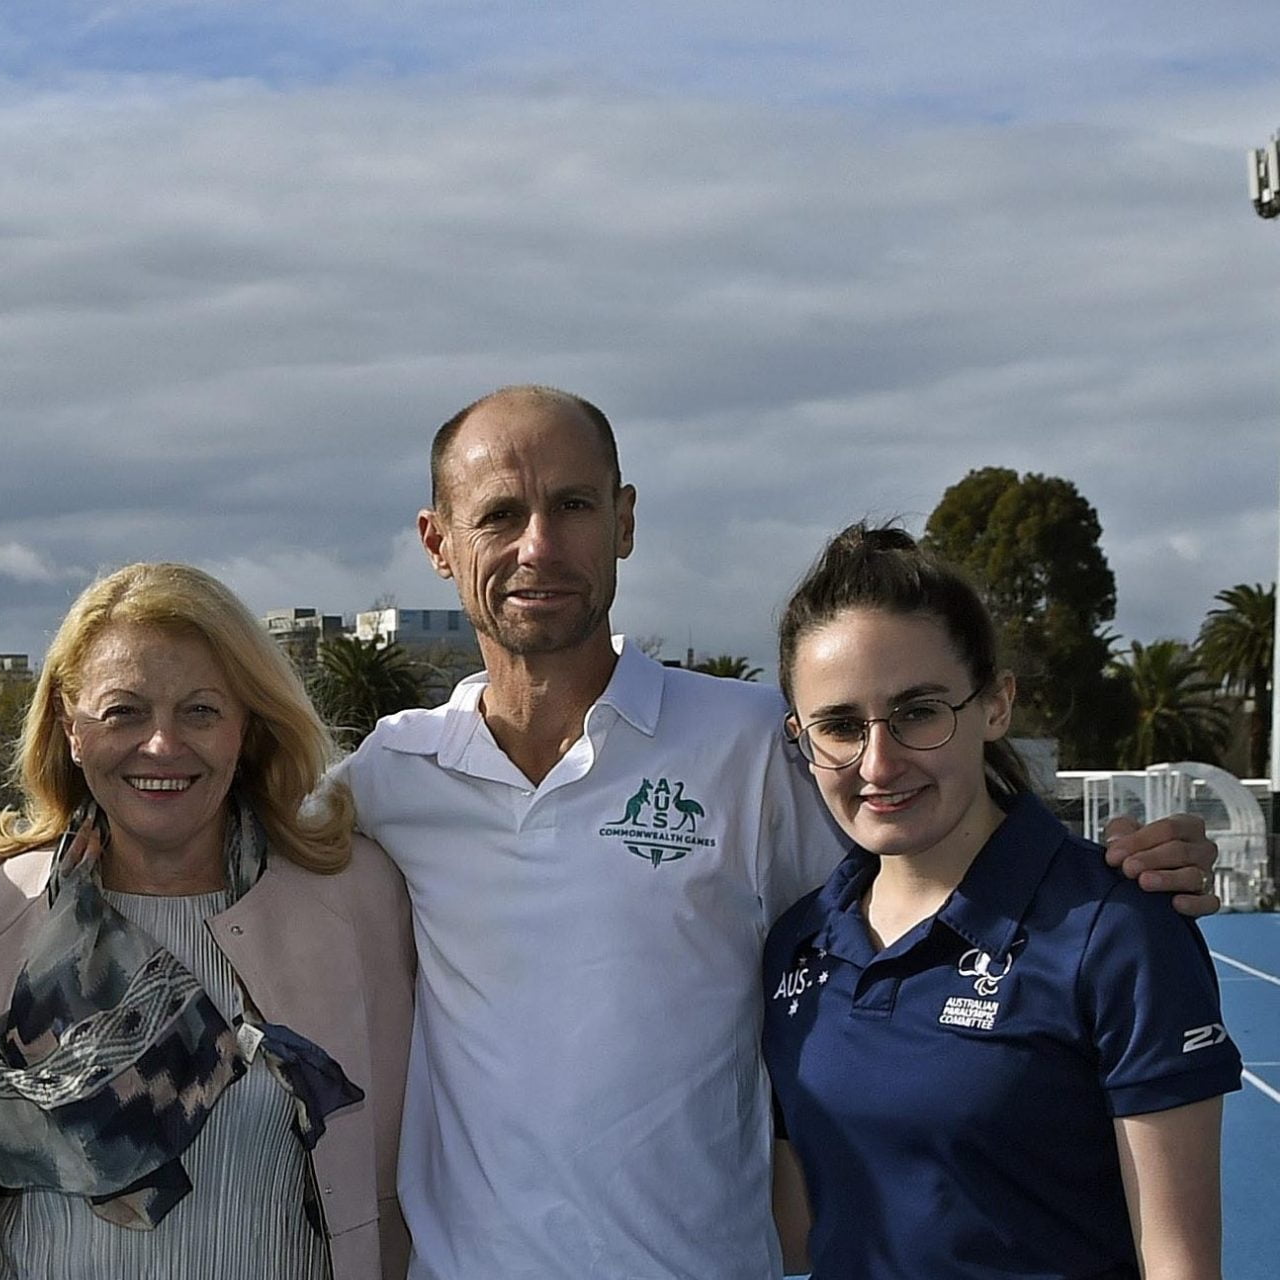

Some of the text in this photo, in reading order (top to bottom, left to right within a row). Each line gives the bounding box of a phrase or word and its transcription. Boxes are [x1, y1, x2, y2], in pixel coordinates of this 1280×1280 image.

[599, 828, 716, 847] COMMONWEALTH GAMES
[773, 968, 809, 999] AUS
[945, 997, 999, 1012] AUSTRALIAN
[939, 1015, 995, 1030] COMMITTEE
